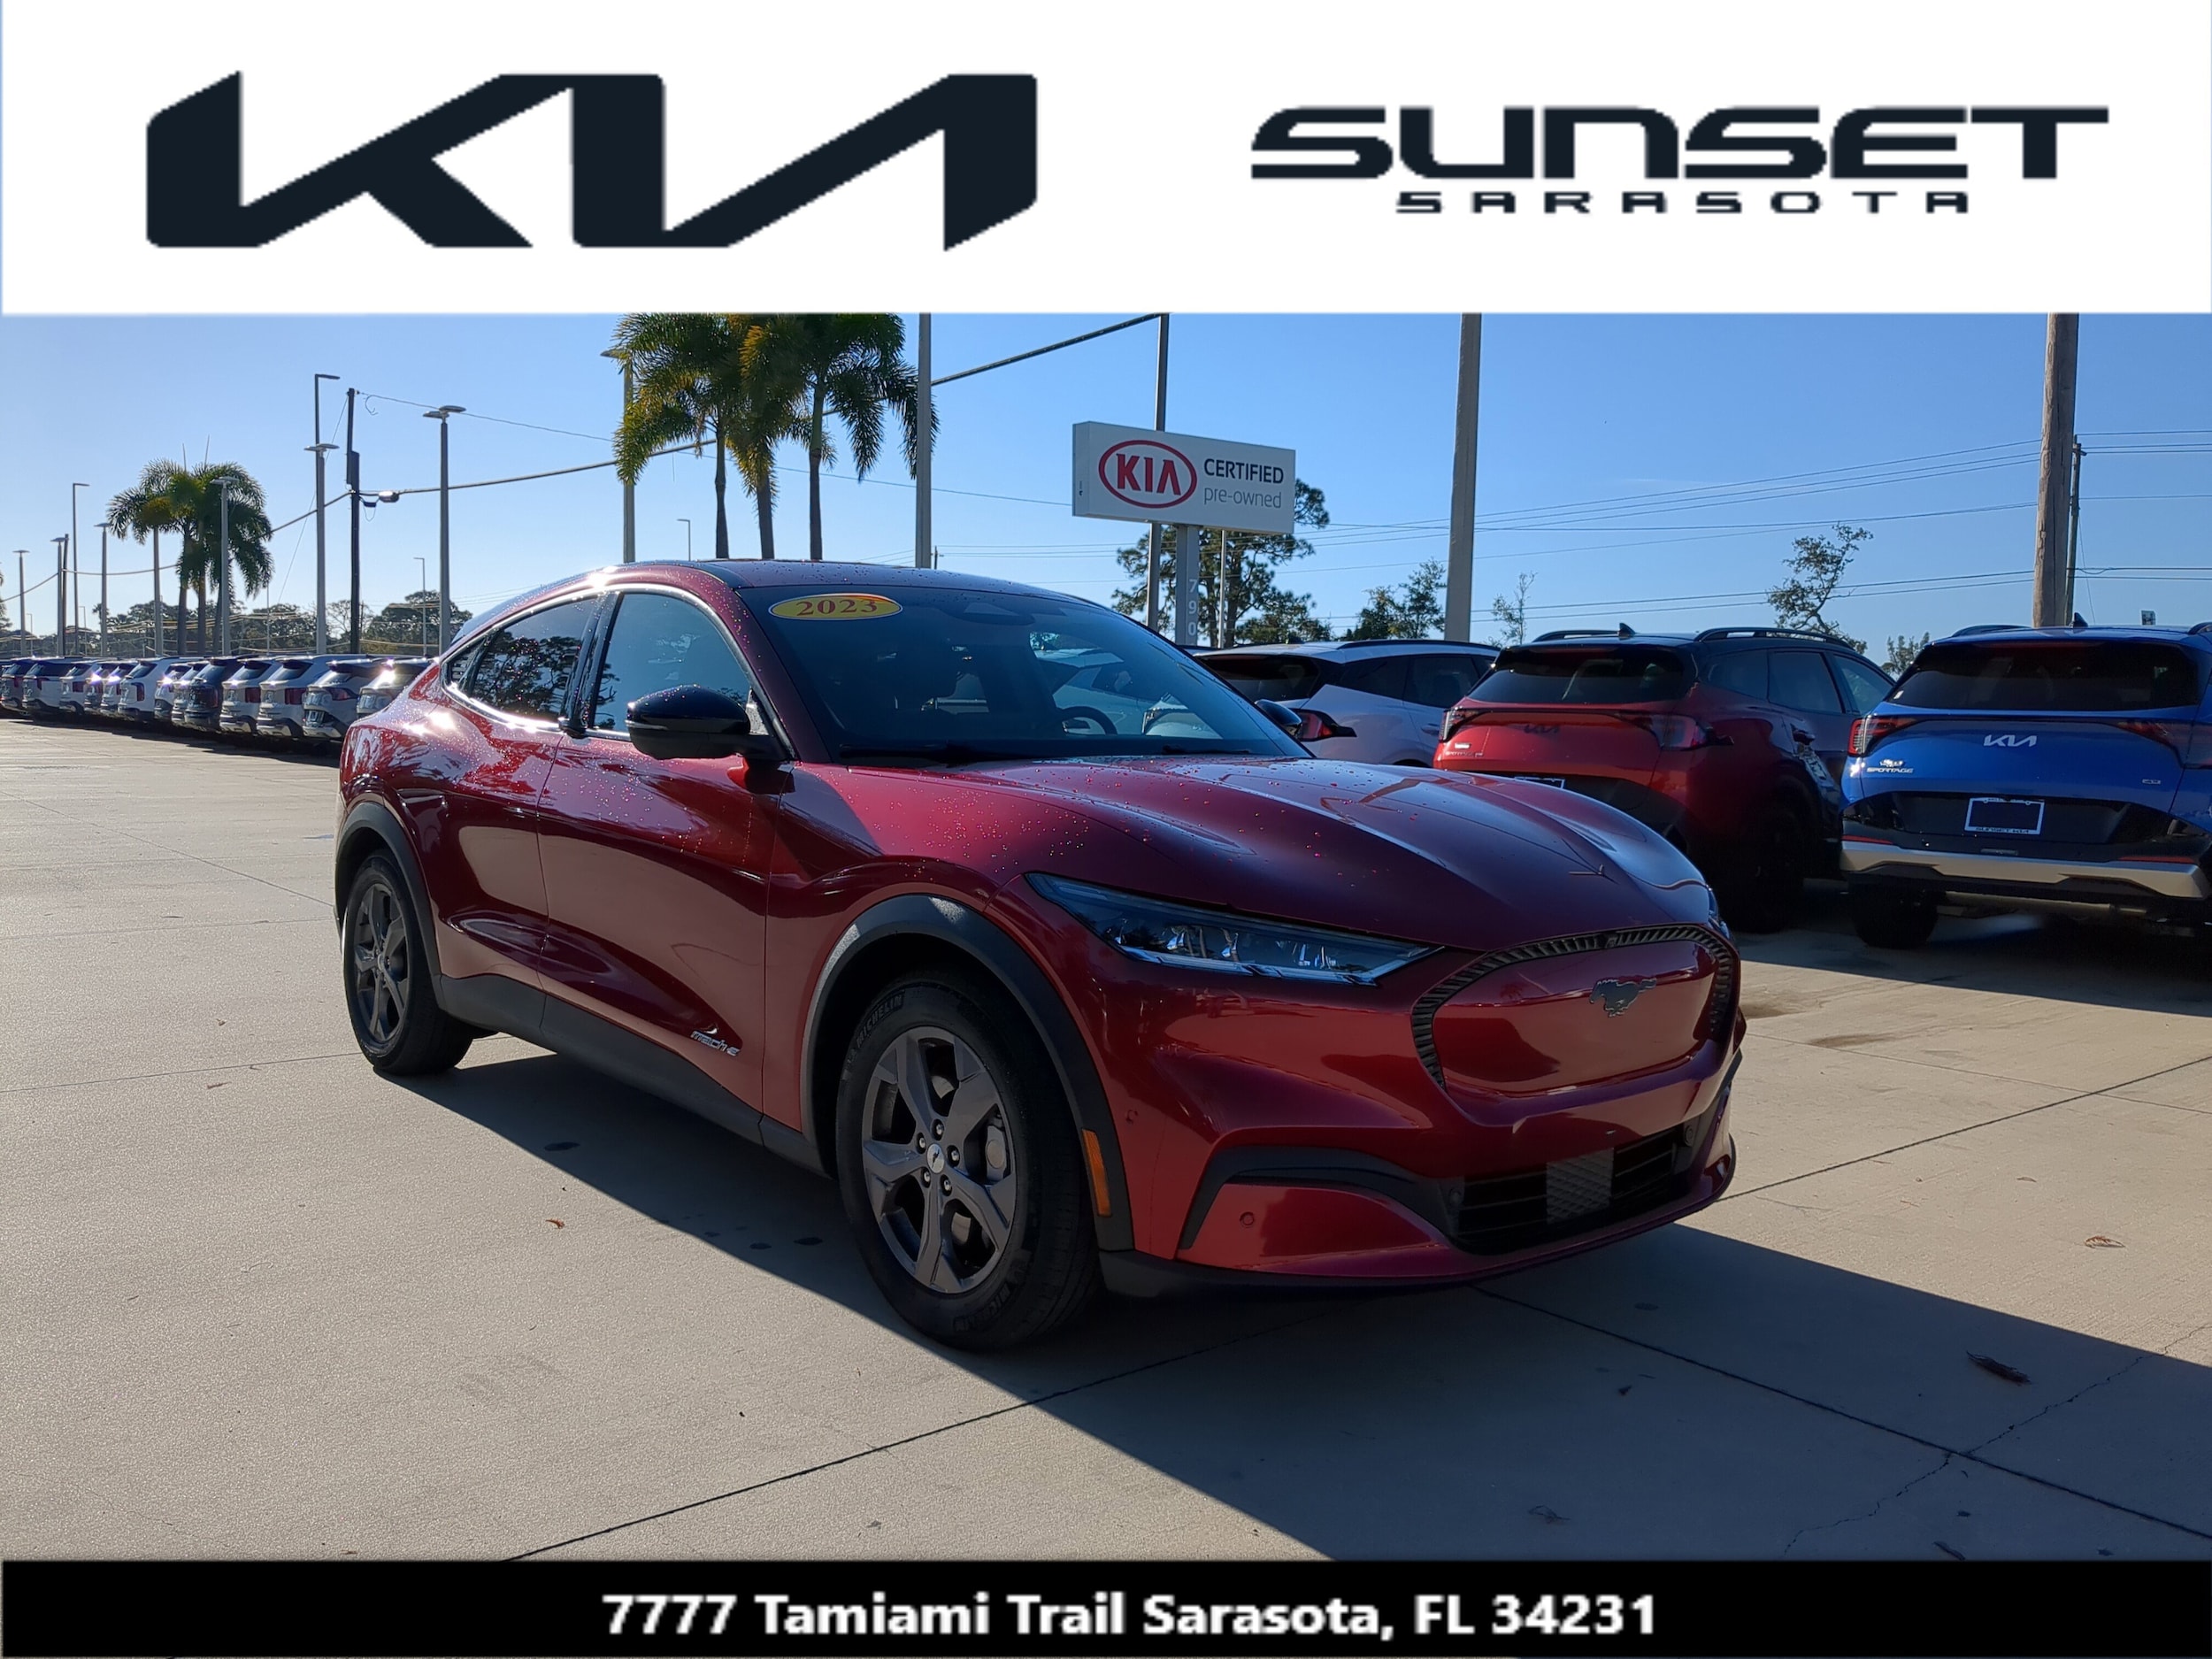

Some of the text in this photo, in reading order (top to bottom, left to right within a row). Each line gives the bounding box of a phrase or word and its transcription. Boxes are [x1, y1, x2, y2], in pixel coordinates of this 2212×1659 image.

[1116, 453, 1181, 495] KIA
[1204, 457, 1284, 484] CERTIFIED
[1204, 486, 1282, 509] pre-owned
[796, 598, 878, 617] 2023
[1187, 579, 1198, 645] 790
[1984, 734, 2038, 747] KIA
